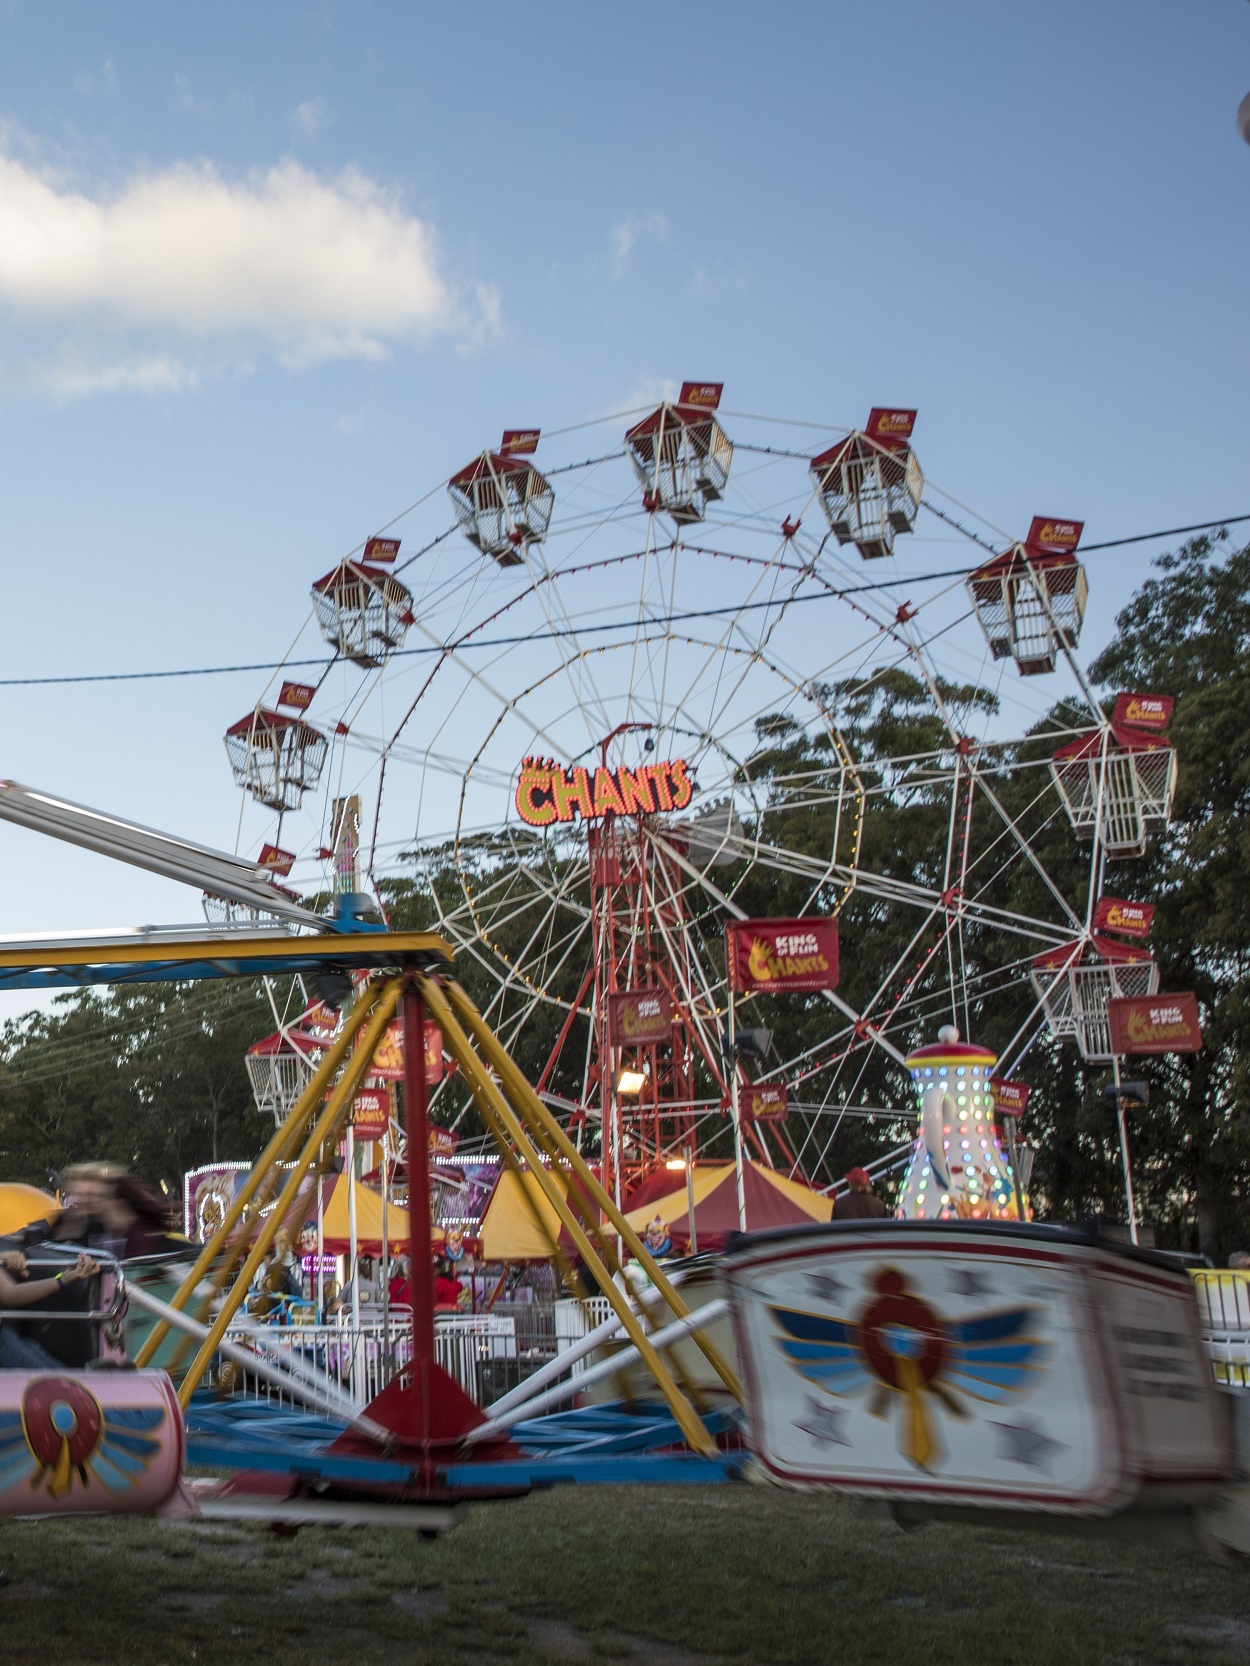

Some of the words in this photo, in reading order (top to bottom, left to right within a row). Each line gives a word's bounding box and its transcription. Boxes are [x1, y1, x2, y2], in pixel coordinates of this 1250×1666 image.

[516, 756, 692, 826] CHANTS
[748, 941, 829, 982] CHANTS
[775, 934, 817, 949] KING
